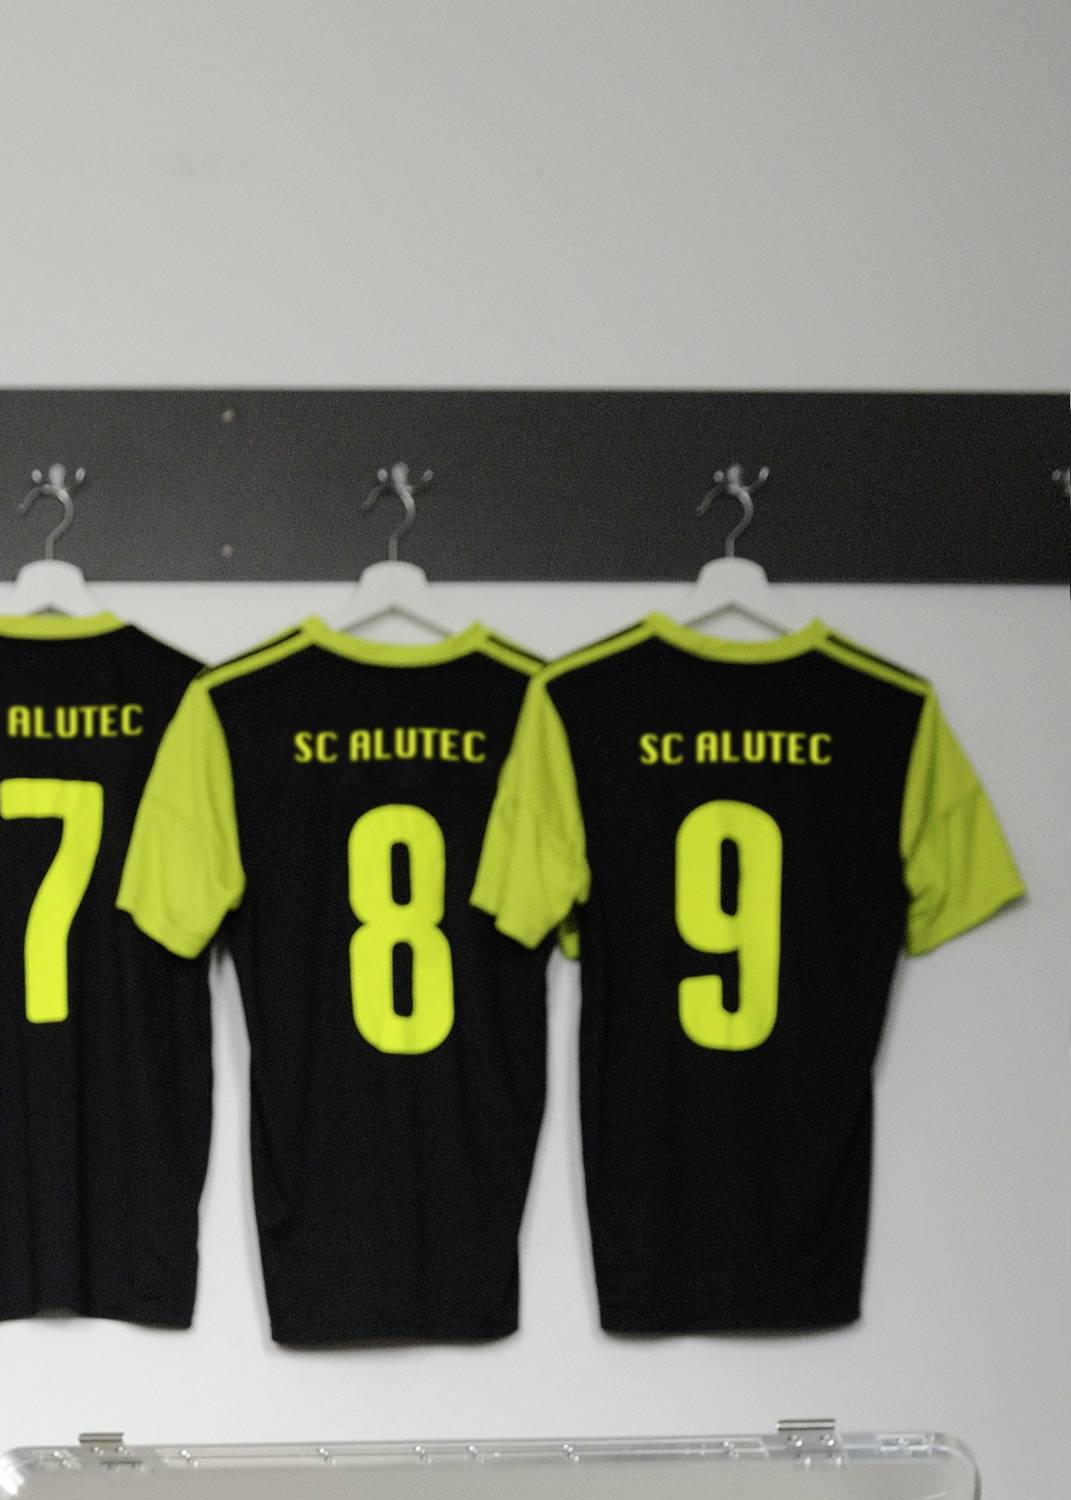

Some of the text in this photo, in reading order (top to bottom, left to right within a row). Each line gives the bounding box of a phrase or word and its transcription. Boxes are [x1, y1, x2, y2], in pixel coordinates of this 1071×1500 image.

[6, 703, 143, 739] ALUTEC
[293, 727, 486, 765] SC ALUTEC
[639, 730, 832, 766] SC ALUTEC
[347, 803, 456, 1055] 8
[674, 799, 783, 1051] 9
